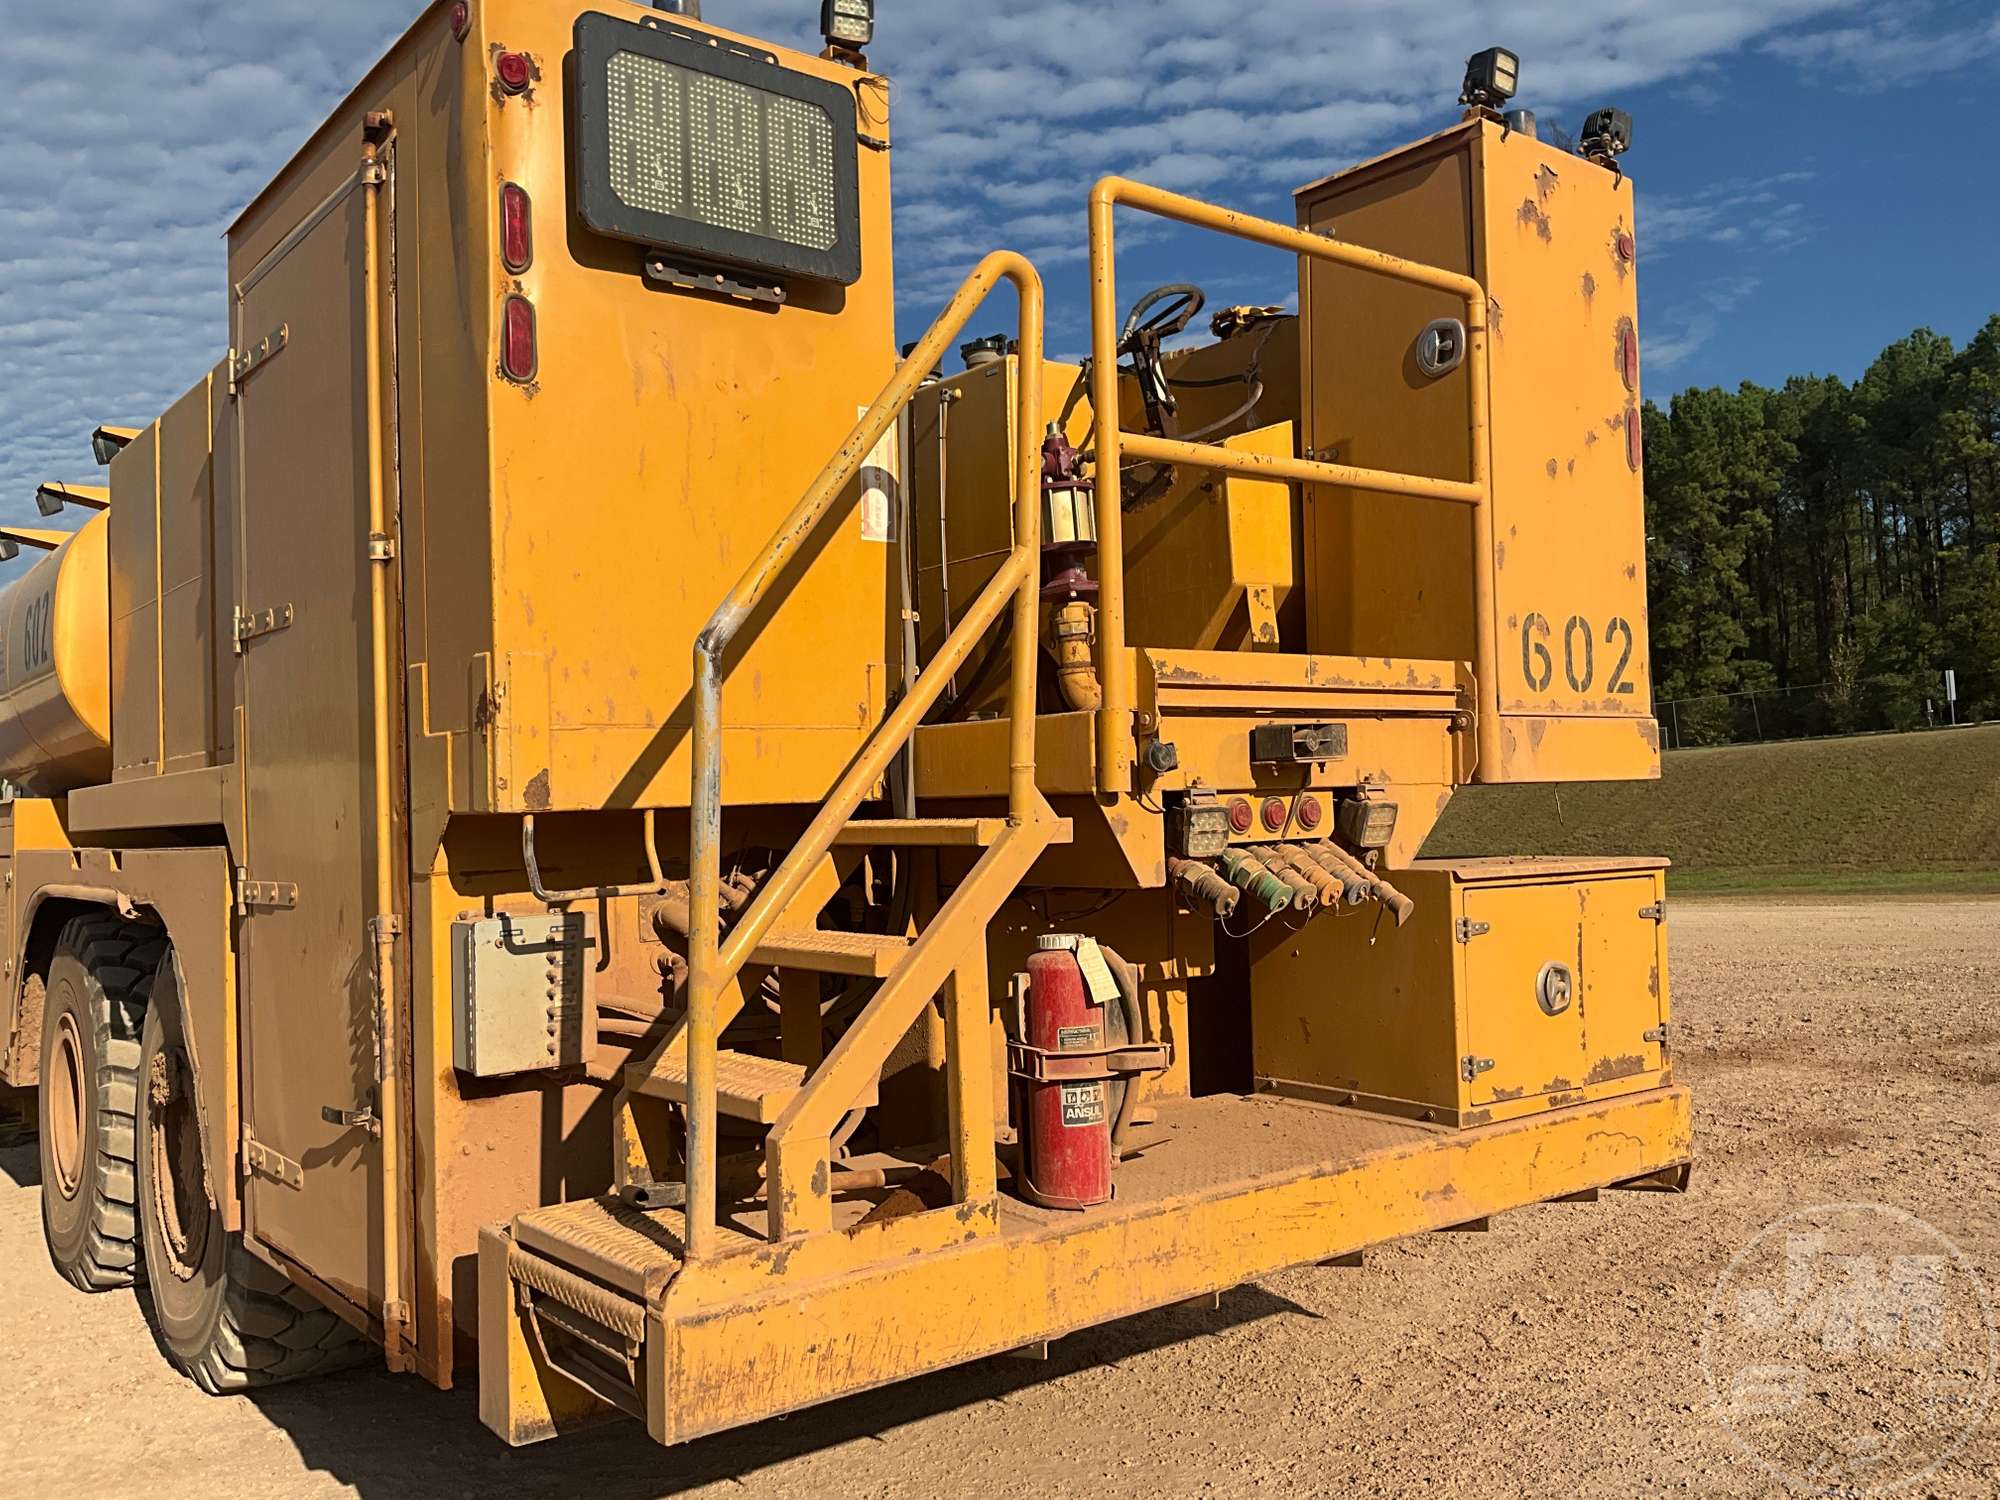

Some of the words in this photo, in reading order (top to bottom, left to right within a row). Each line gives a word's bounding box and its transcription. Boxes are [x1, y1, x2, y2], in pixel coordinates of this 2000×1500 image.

[24, 590, 49, 671] 602
[1521, 612, 1634, 693] 602
[1066, 1104, 1103, 1119] ANSUL
